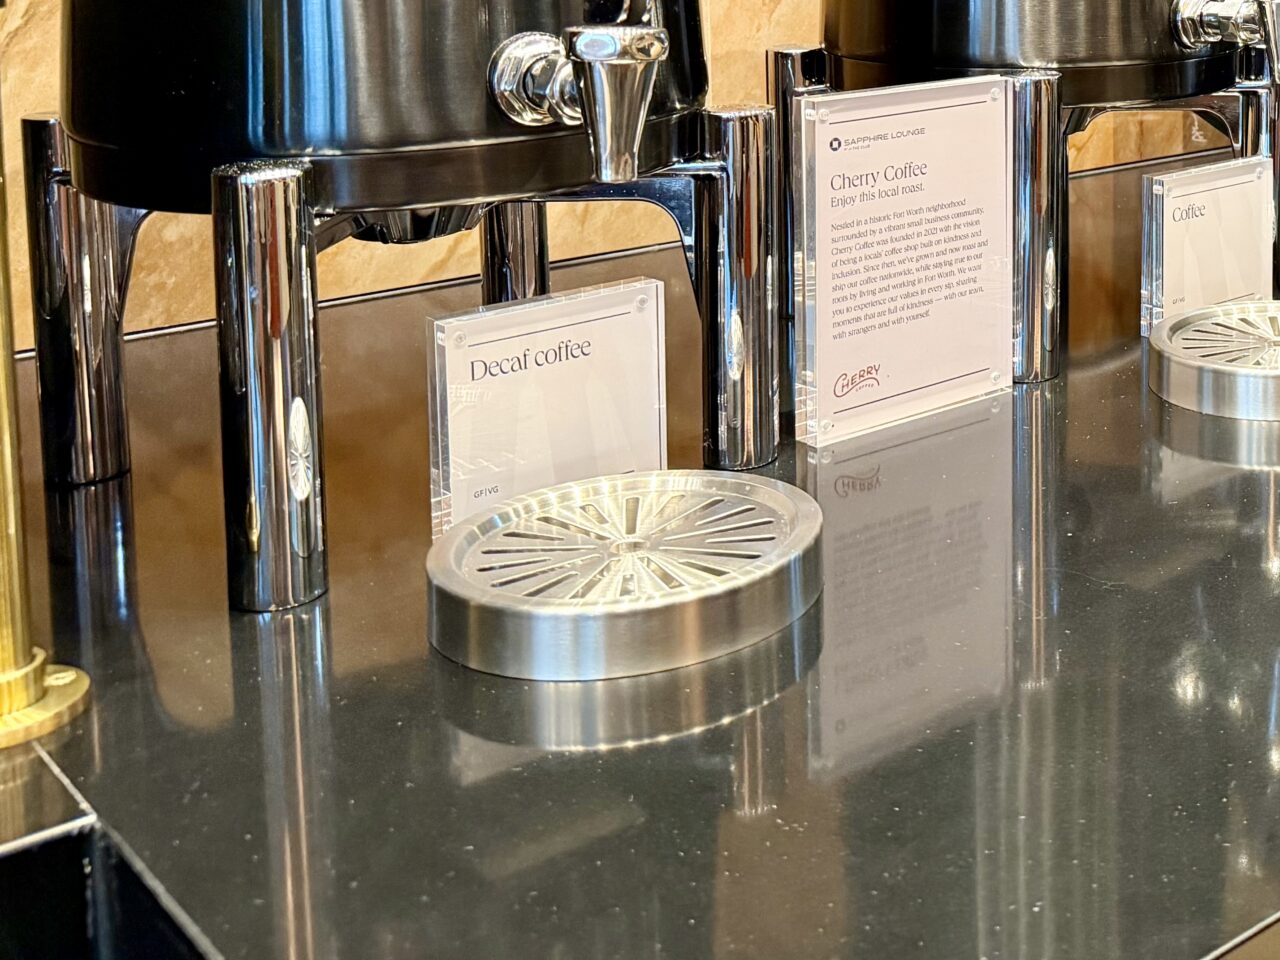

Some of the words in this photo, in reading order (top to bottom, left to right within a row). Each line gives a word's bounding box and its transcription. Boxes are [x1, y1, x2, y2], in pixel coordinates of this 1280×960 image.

[844, 133, 888, 146] SAPPHIRE
[891, 127, 925, 138] LOUNGE
[830, 171, 880, 190] Cherry
[884, 161, 927, 181] Coffee
[831, 195, 856, 207] Enjoy
[859, 190, 875, 202] this
[878, 185, 898, 198] local
[901, 183, 924, 194] roast.
[831, 220, 854, 231] Nestled
[869, 214, 891, 223] historic
[892, 211, 904, 219] Fort
[905, 207, 924, 215] Worth
[925, 198, 966, 213] neighborhood
[831, 229, 867, 243] surrounded
[884, 223, 905, 232] vibrant
[906, 218, 923, 228] small
[924, 214, 950, 224] business
[1172, 203, 1206, 223] Coffee
[831, 246, 854, 255] Cherry
[854, 241, 874, 250] Coffee
[890, 231, 914, 243] founded
[923, 227, 937, 236] 2021
[938, 224, 951, 232] with
[953, 222, 961, 230] the
[962, 219, 980, 227] vision
[831, 259, 838, 268] of
[839, 256, 857, 266] being
[884, 247, 902, 256] coffee
[903, 244, 918, 252] shop
[920, 240, 933, 248] built
[943, 233, 969, 243] kindness
[970, 229, 981, 238] and
[832, 283, 846, 292] ship
[846, 280, 857, 288] our
[859, 276, 877, 286] coffee
[915, 263, 931, 272] while
[932, 259, 953, 269] staying
[972, 252, 982, 260] our
[863, 264, 879, 273] Since
[915, 252, 934, 262] grown
[935, 248, 947, 257] and
[962, 242, 976, 251] roast
[977, 239, 988, 247] and
[832, 295, 848, 304] roots
[849, 292, 857, 301] by
[859, 288, 876, 298] living
[877, 284, 890, 293] and
[891, 279, 916, 289] working
[924, 274, 936, 282] Fort
[832, 308, 844, 318] you
[853, 298, 886, 311] experience
[887, 295, 898, 303] our
[899, 291, 919, 299] values
[927, 285, 943, 293] every
[955, 276, 977, 286] sharing
[832, 316, 862, 328] moments
[863, 312, 875, 320] that
[887, 305, 897, 314] full
[898, 303, 905, 311] of
[906, 298, 933, 310] kindness
[943, 292, 956, 300] with
[832, 331, 846, 340] with
[848, 324, 876, 336] strangers
[877, 319, 890, 329] and
[891, 316, 904, 325] with
[470, 347, 529, 381] Decaf
[534, 339, 592, 367] coffee
[833, 364, 880, 397] CHERRY
